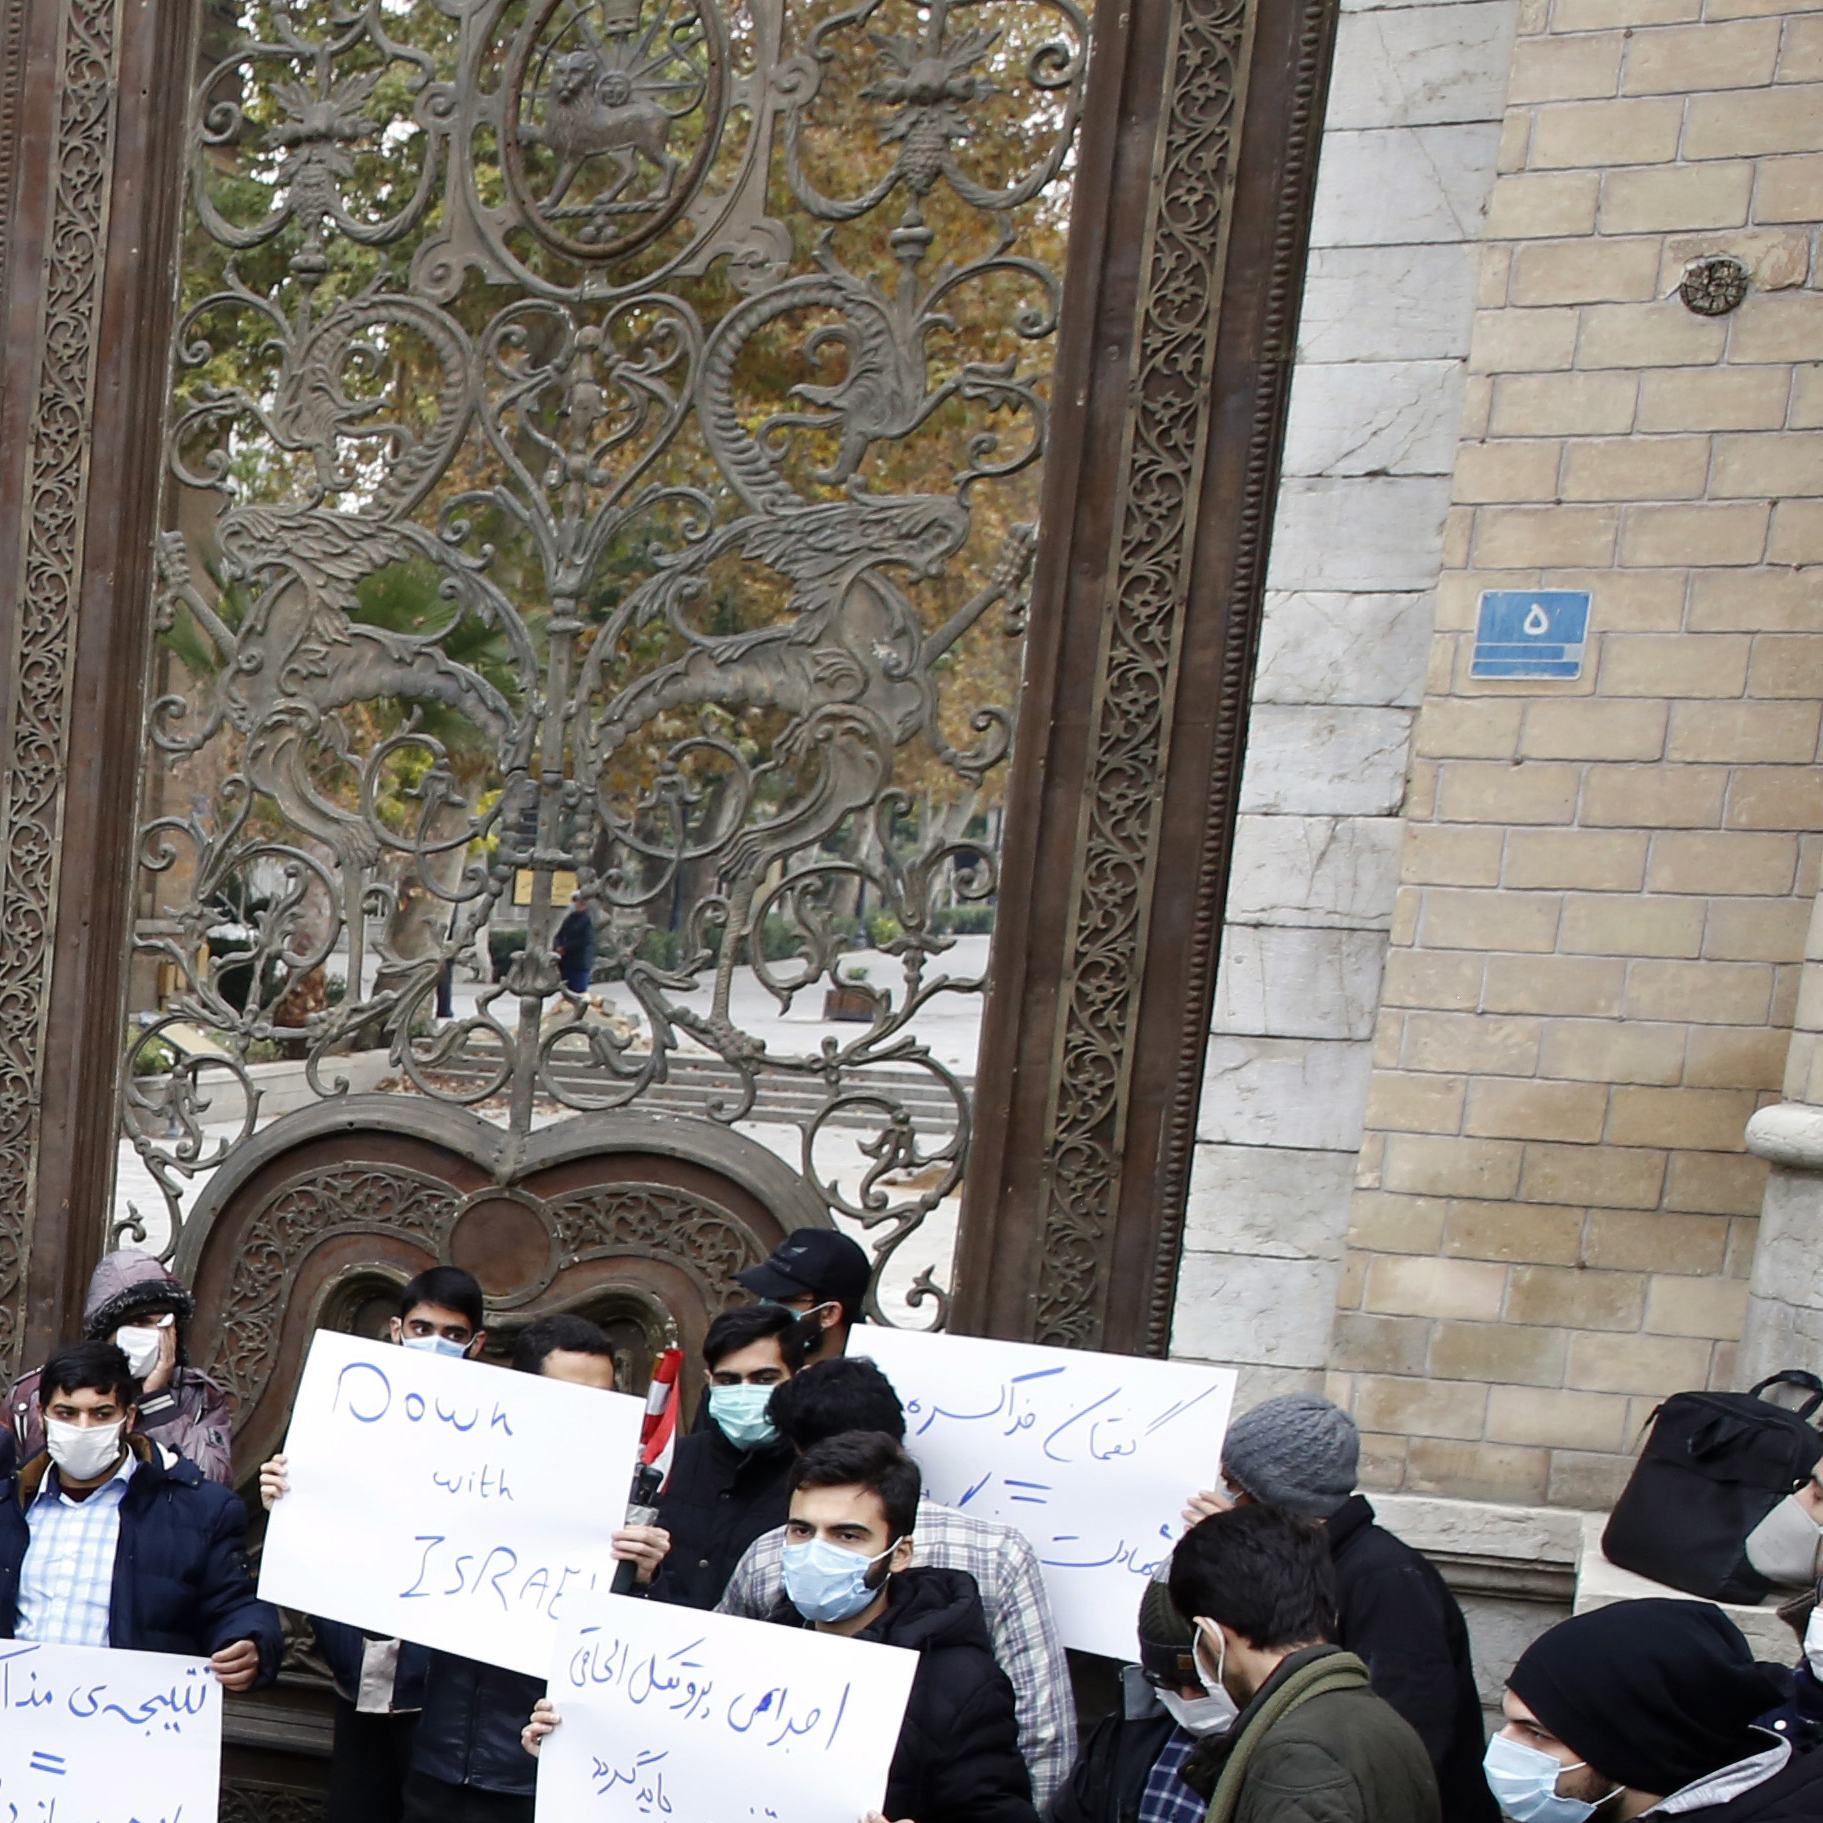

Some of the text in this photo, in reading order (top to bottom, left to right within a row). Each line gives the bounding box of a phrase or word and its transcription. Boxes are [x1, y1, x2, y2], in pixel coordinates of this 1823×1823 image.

[1523, 602, 1550, 636] ۵
[332, 1362, 514, 1436] Down
[433, 1464, 515, 1501] with
[1041, 1523, 1174, 1576] هادت
[399, 1535, 595, 1619] ISRAE
